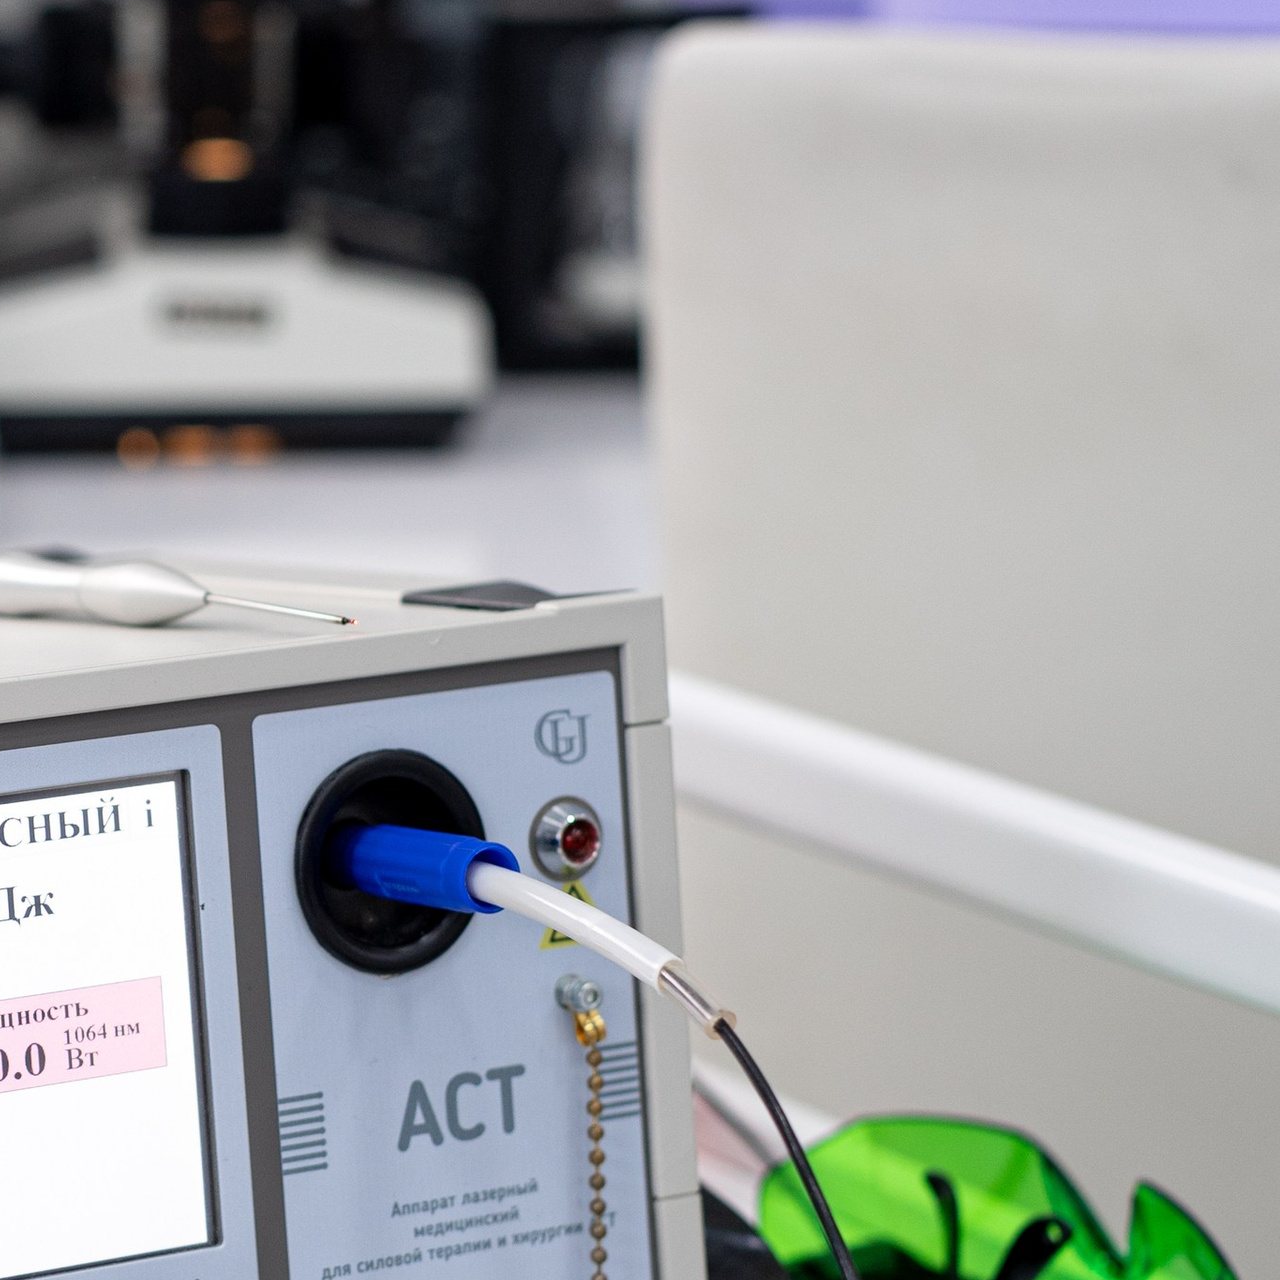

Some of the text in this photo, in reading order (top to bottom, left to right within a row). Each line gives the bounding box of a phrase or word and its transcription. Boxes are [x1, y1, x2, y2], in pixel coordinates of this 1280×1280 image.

[63, 1022, 141, 1045] 1064 нм
[66, 1048, 99, 1070] Вт
[391, 1177, 539, 1218] Аппарат лазерный
[414, 1206, 519, 1238] медицинский
[356, 1249, 423, 1274] силовой
[428, 1237, 492, 1262] терапии
[497, 1234, 507, 1248] и
[512, 1219, 583, 1247] хирургии
